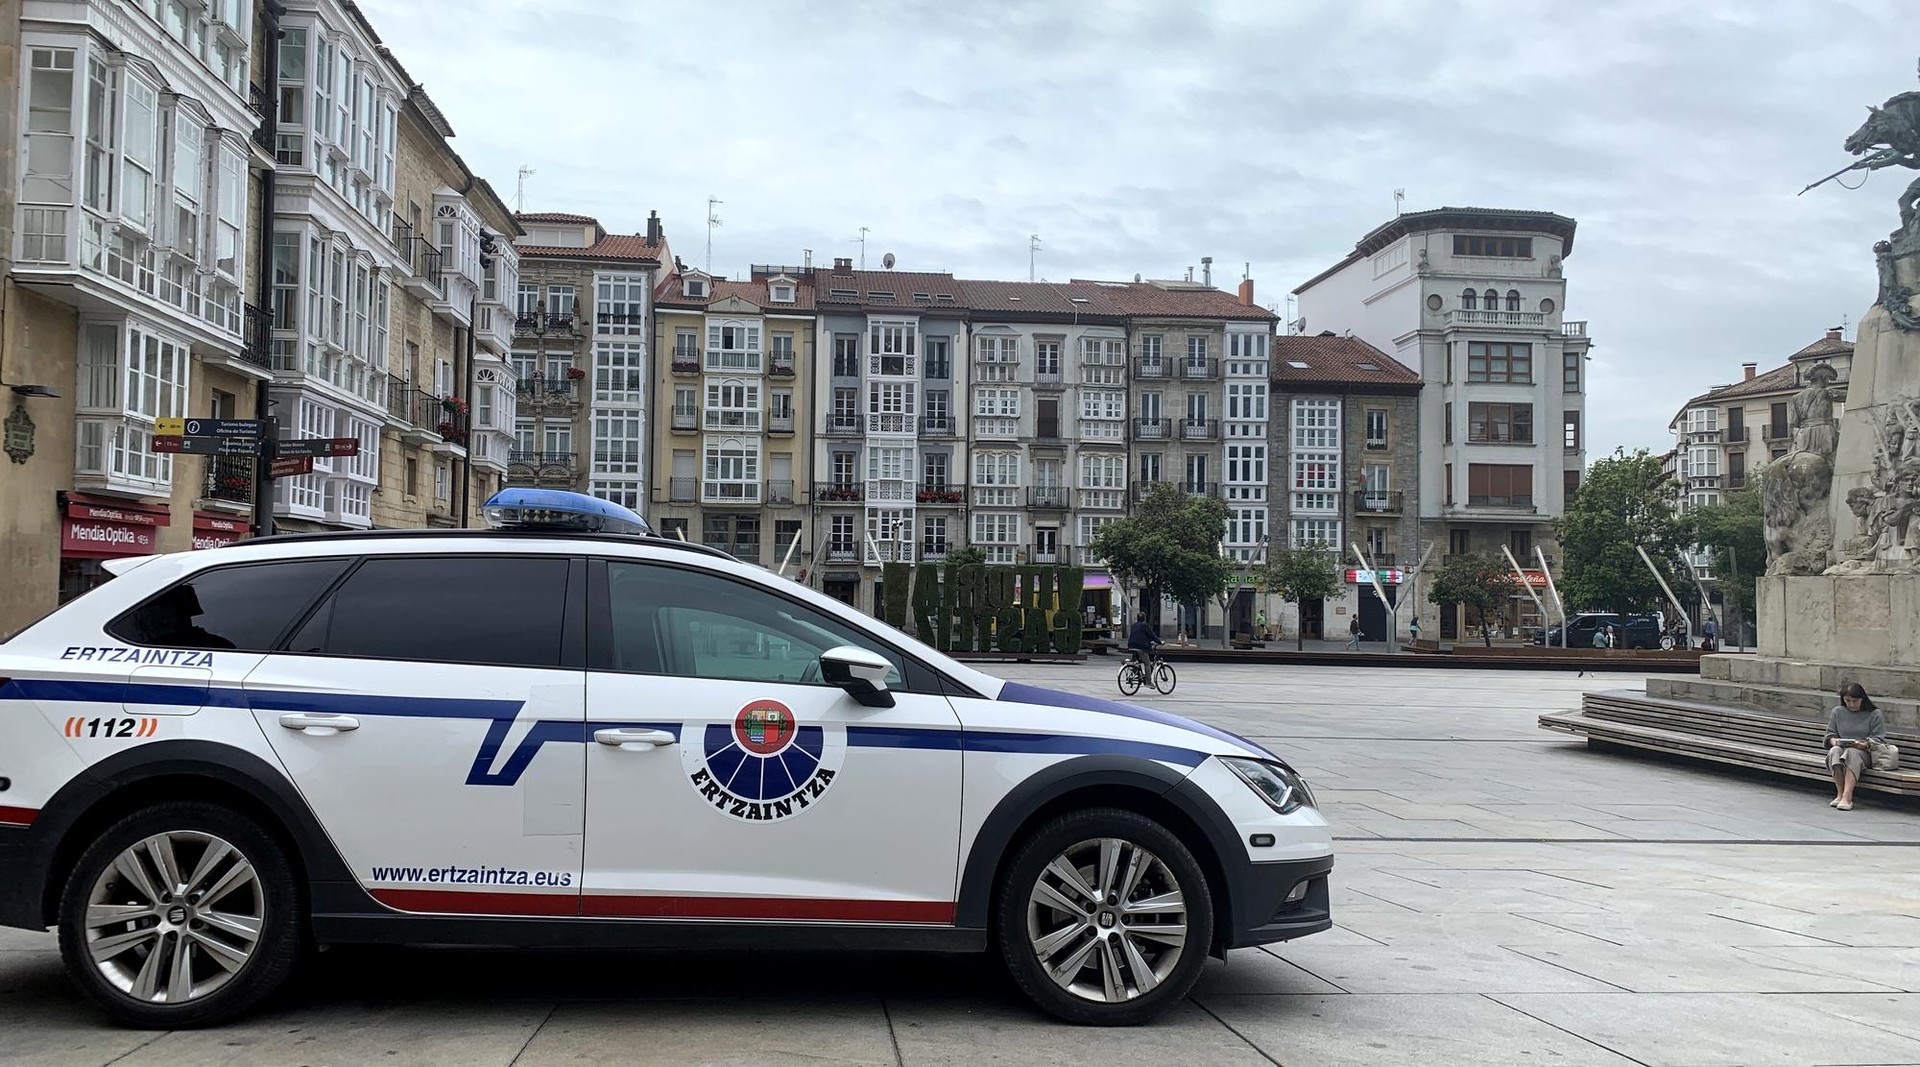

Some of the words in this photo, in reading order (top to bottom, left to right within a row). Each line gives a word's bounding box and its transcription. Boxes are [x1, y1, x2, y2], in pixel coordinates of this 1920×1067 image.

[60, 646, 214, 668] ERTZAINTZA
[690, 767, 836, 820] ERTZAINTZA
[372, 865, 572, 887] www.ertzaintza.eus
